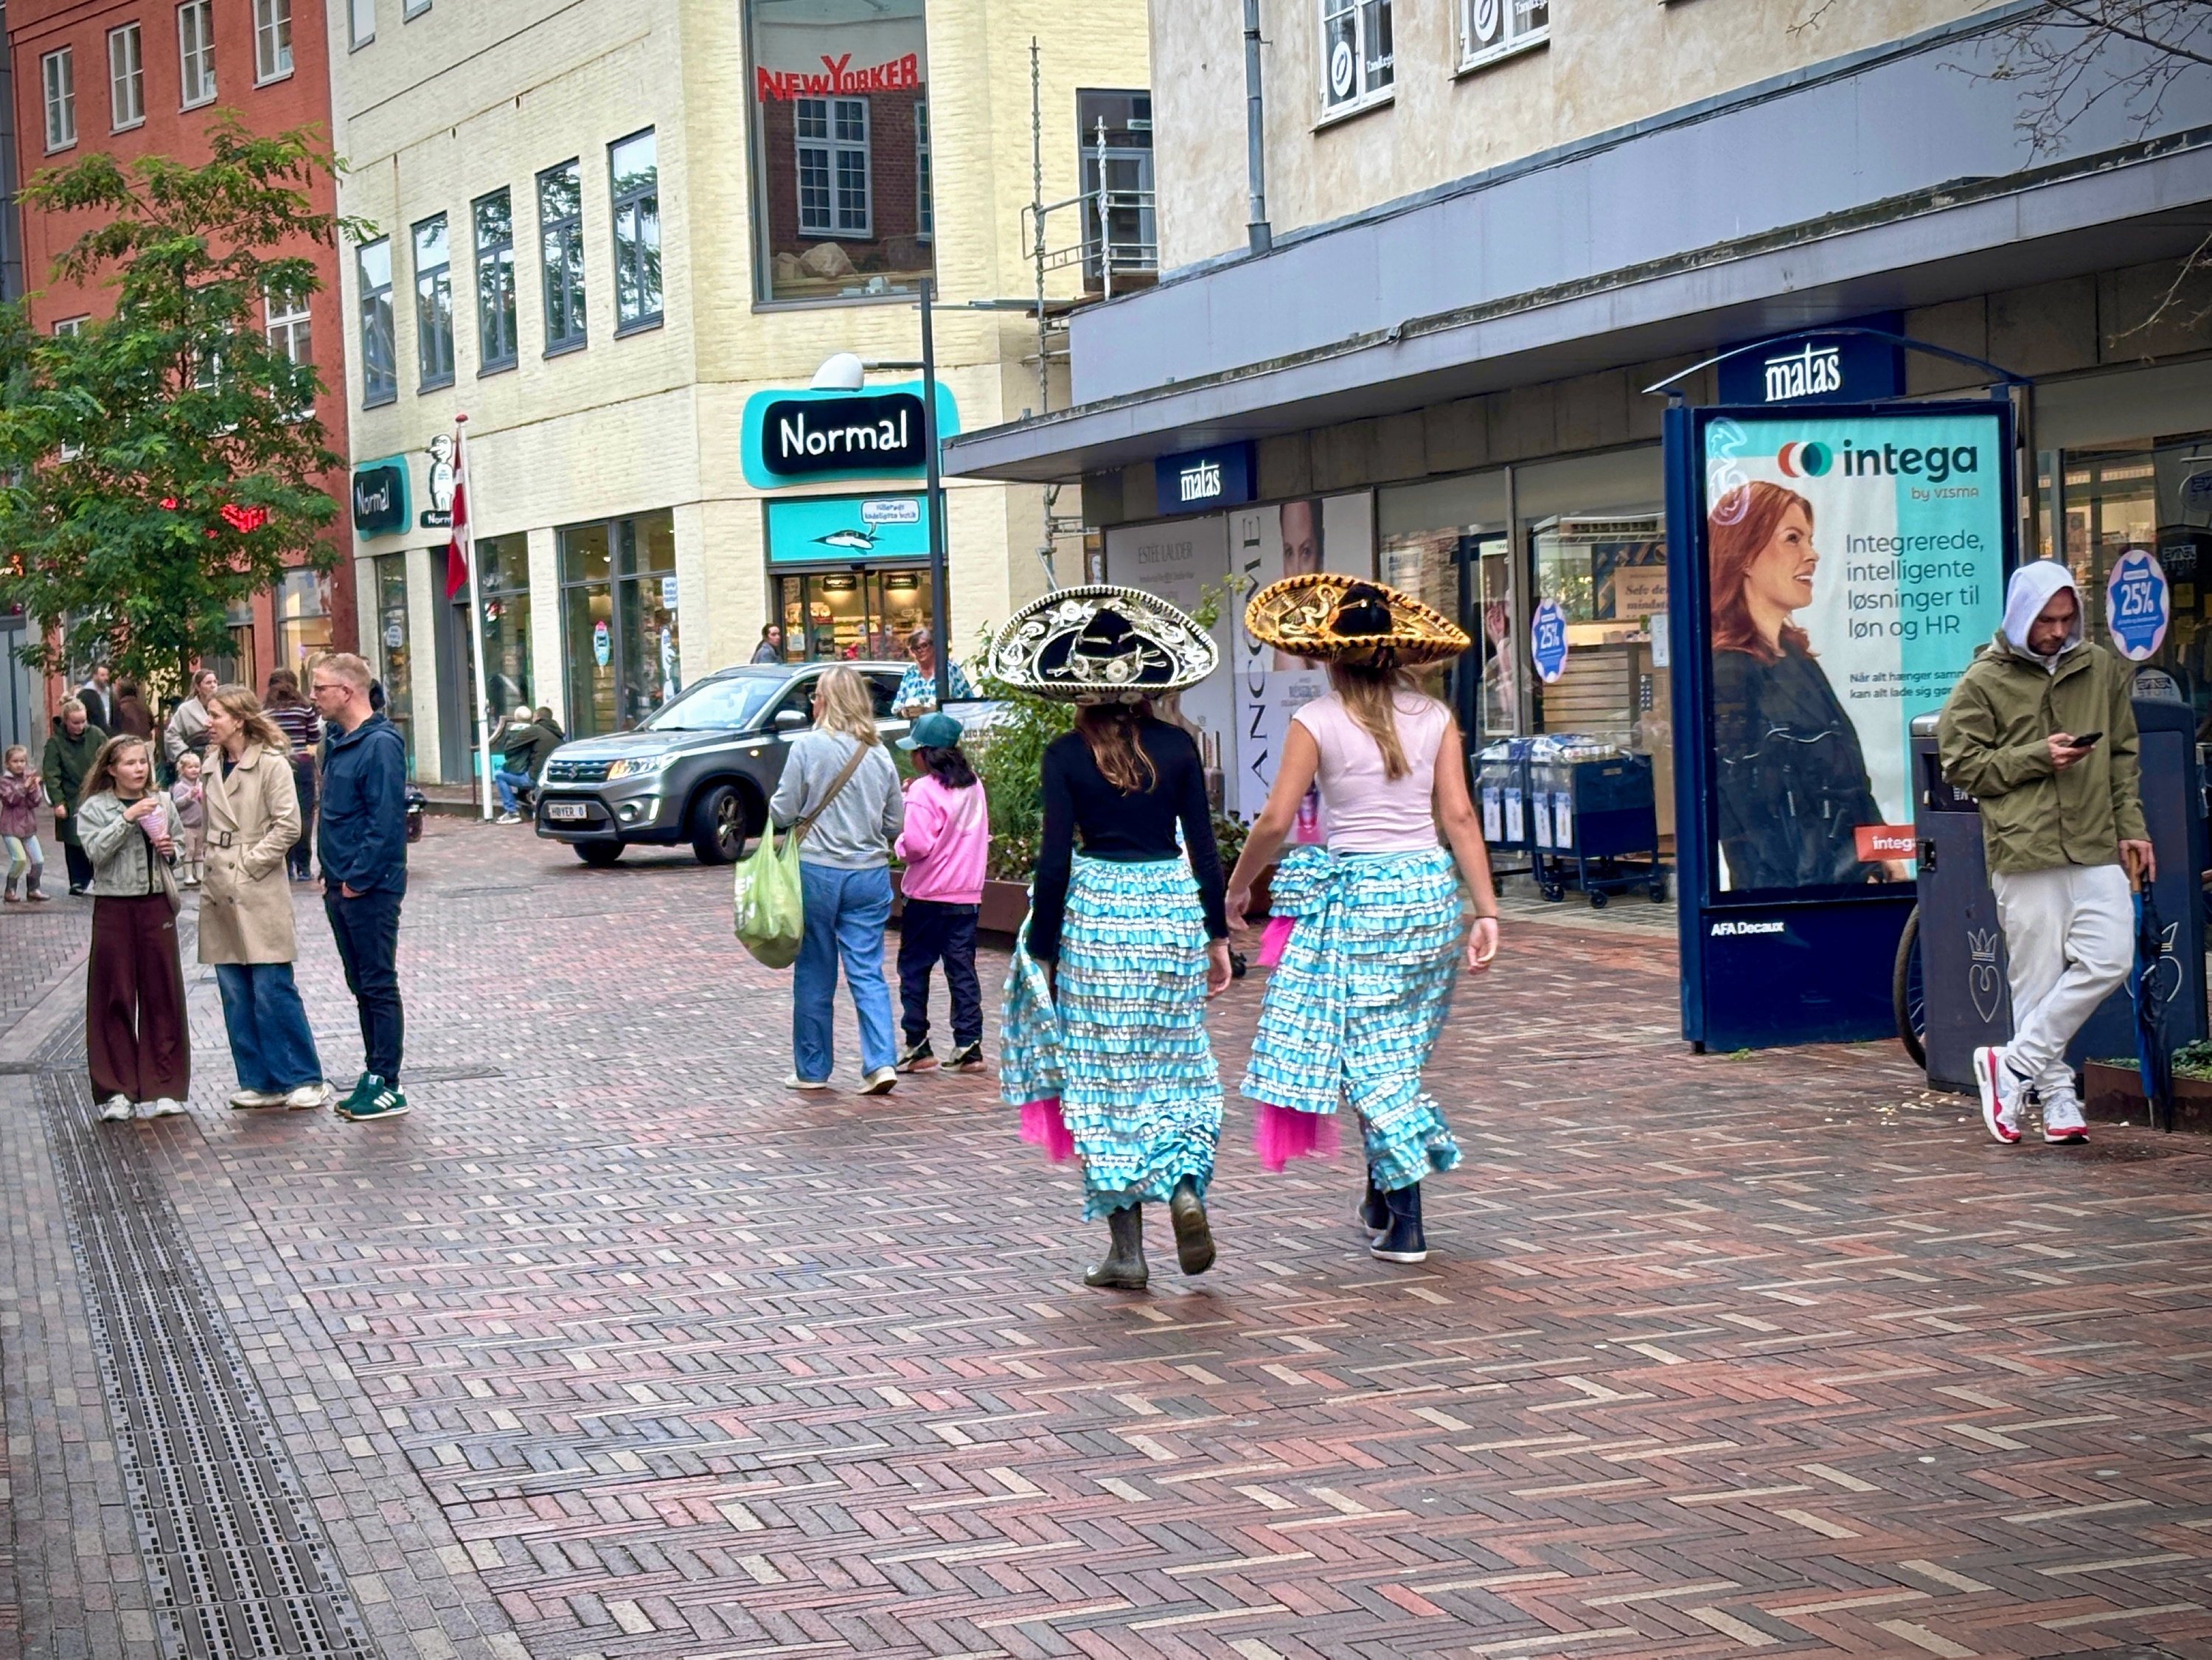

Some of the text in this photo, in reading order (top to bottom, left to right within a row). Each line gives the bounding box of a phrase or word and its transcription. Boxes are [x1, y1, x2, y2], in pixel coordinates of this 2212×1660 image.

[1764, 342, 1841, 402] matas
[781, 409, 907, 458] Normal
[1843, 440, 1978, 483] intega
[1180, 459, 1220, 501] matas
[356, 479, 390, 517] Normal
[1911, 487, 1930, 501] by
[1161, 541, 1193, 562] LAUDER
[1846, 529, 1984, 557] Integrerede,
[1846, 559, 1975, 584] intelligente
[1848, 585, 1979, 611] løsninger til
[2121, 581, 2154, 616] 25%
[1540, 622, 1560, 649] 25%
[1848, 614, 1960, 641] løn og HR
[1850, 673, 1869, 683] Når
[1872, 673, 1887, 682] alt
[1889, 672, 1932, 683] hænger
[1850, 689, 1871, 698] kan
[1874, 688, 1888, 698] alt
[1890, 687, 1913, 697] lade
[1915, 687, 1931, 698] sig
[1711, 922, 1784, 936] AFA Decaux
